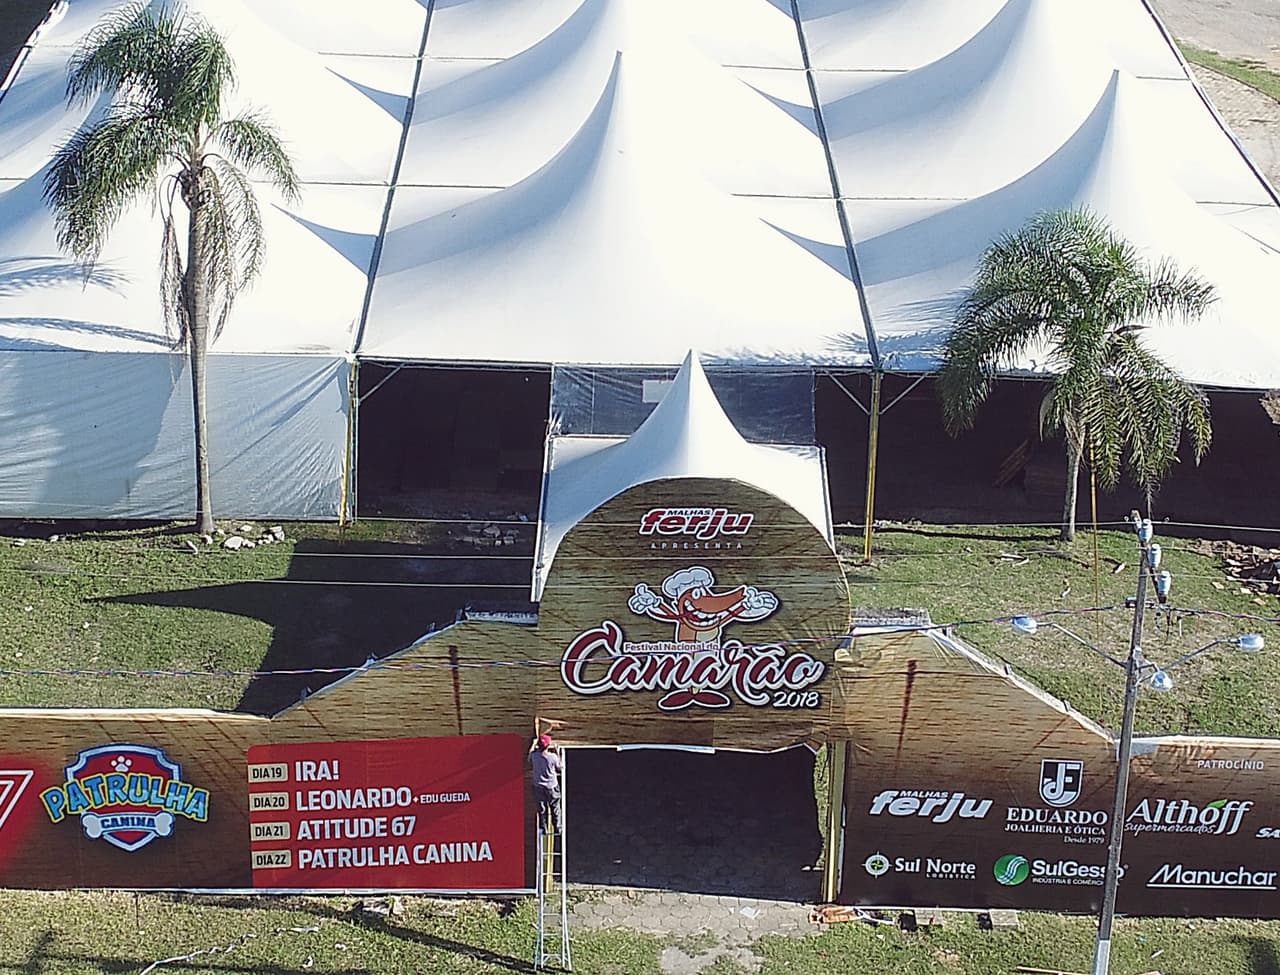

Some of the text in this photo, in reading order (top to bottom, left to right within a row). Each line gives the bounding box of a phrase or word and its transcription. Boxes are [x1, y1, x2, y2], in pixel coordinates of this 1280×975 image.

[639, 508, 754, 540] ferju
[650, 542, 742, 550] APRESENTA
[624, 642, 662, 653] Festival
[663, 642, 705, 653] Nacional
[561, 621, 824, 706] Camarão
[773, 691, 819, 707] 2018
[295, 760, 340, 782] IRA!
[1197, 759, 1264, 770] PATROCÍNIO
[253, 767, 282, 779] DIA 19
[39, 772, 210, 824] PATRULHA
[254, 796, 285, 808] DIA 20
[296, 787, 412, 811] LEONARDO
[420, 794, 439, 804] EDU
[900, 790, 949, 798] MALHAS
[869, 790, 993, 823] ferju
[101, 816, 157, 829] CANINA
[1006, 807, 1108, 825] EDUARDO
[1125, 798, 1254, 835] Althoff
[255, 826, 284, 837] DIA 21
[297, 816, 416, 840] ATITUDE 67
[1004, 824, 1063, 834] JOALHERIA
[1065, 825, 1072, 834] E
[1123, 823, 1216, 837] supermercados
[256, 854, 287, 866] DIA 22
[299, 841, 493, 869] PATRULHA CANINA
[895, 857, 976, 874] Sul Norte
[1148, 864, 1277, 886] Manuchar
